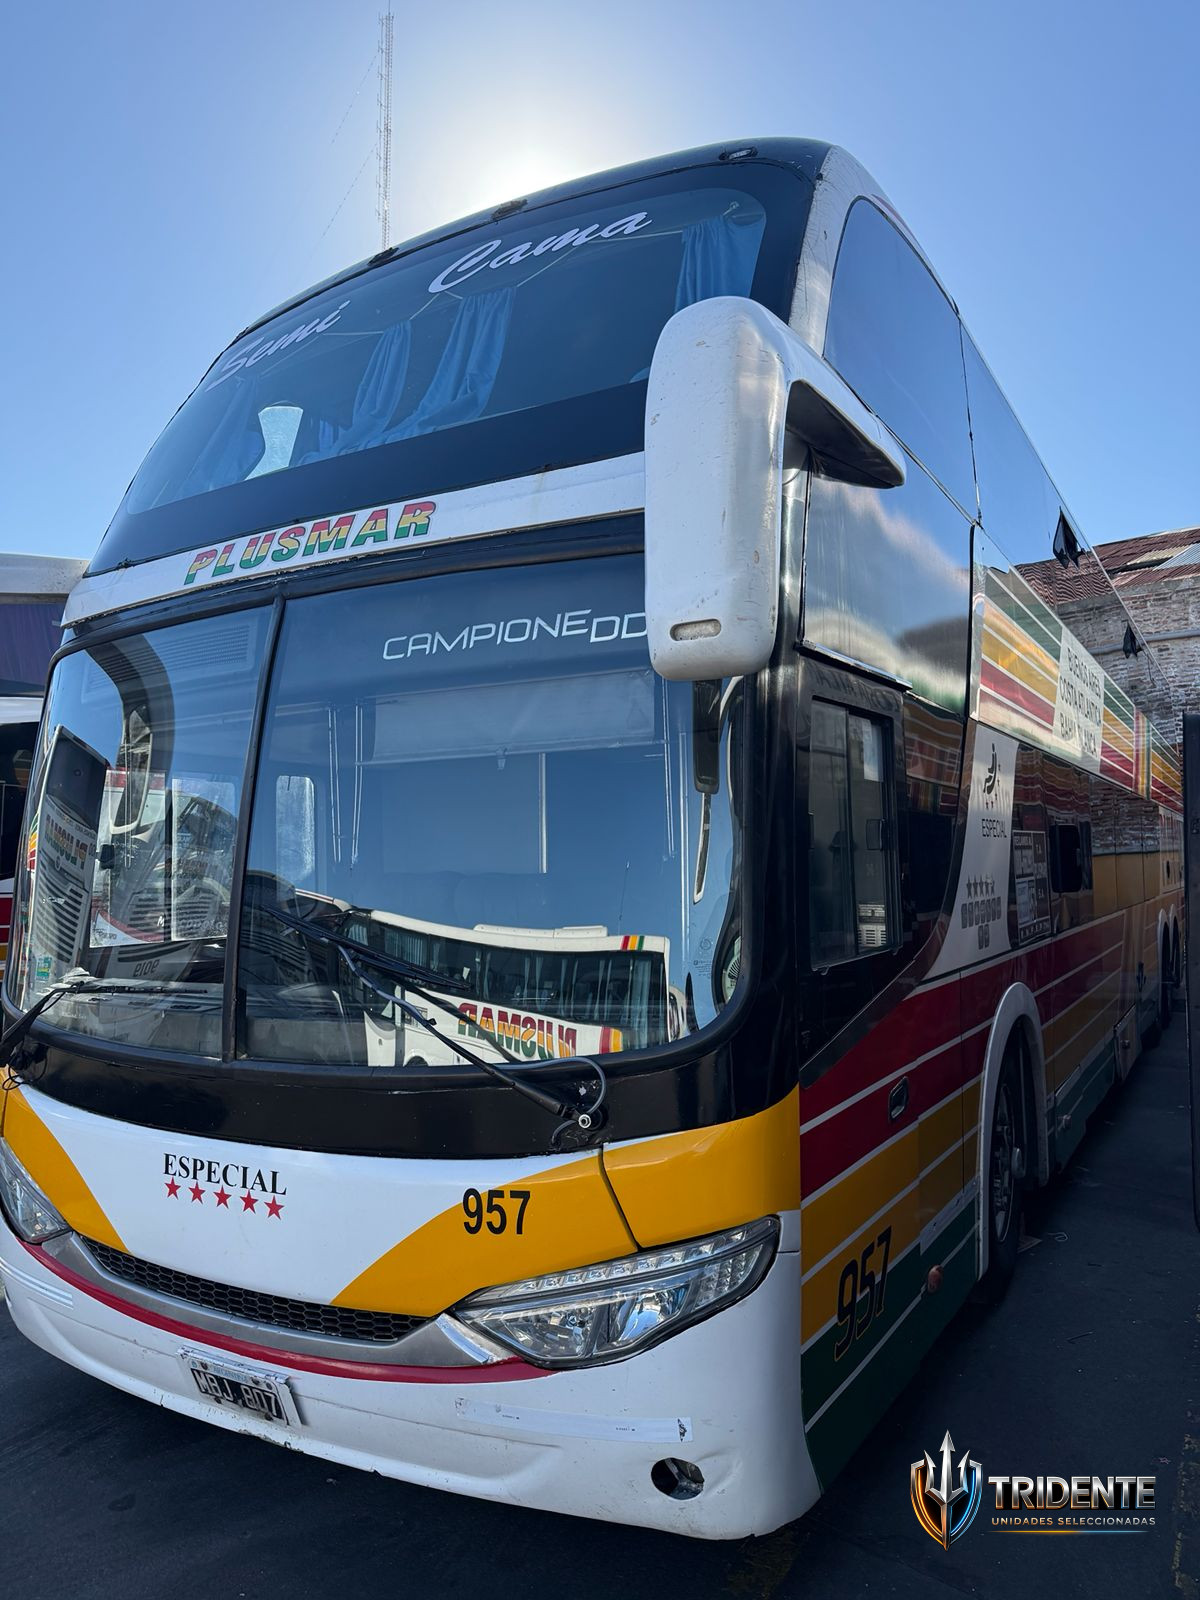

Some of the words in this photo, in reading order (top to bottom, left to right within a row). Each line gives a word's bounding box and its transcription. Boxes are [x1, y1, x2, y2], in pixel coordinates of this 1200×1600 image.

[205, 300, 351, 392] Semi
[428, 211, 654, 294] Cama
[183, 500, 437, 585] PLUSMAR
[981, 818, 1008, 838] ESPECIAL
[163, 1153, 287, 1195] ESPECIAL
[462, 1188, 531, 1235] 957
[834, 1226, 892, 1363] 957
[193, 1369, 234, 1401] MBJ
[240, 1384, 278, 1417] 807
